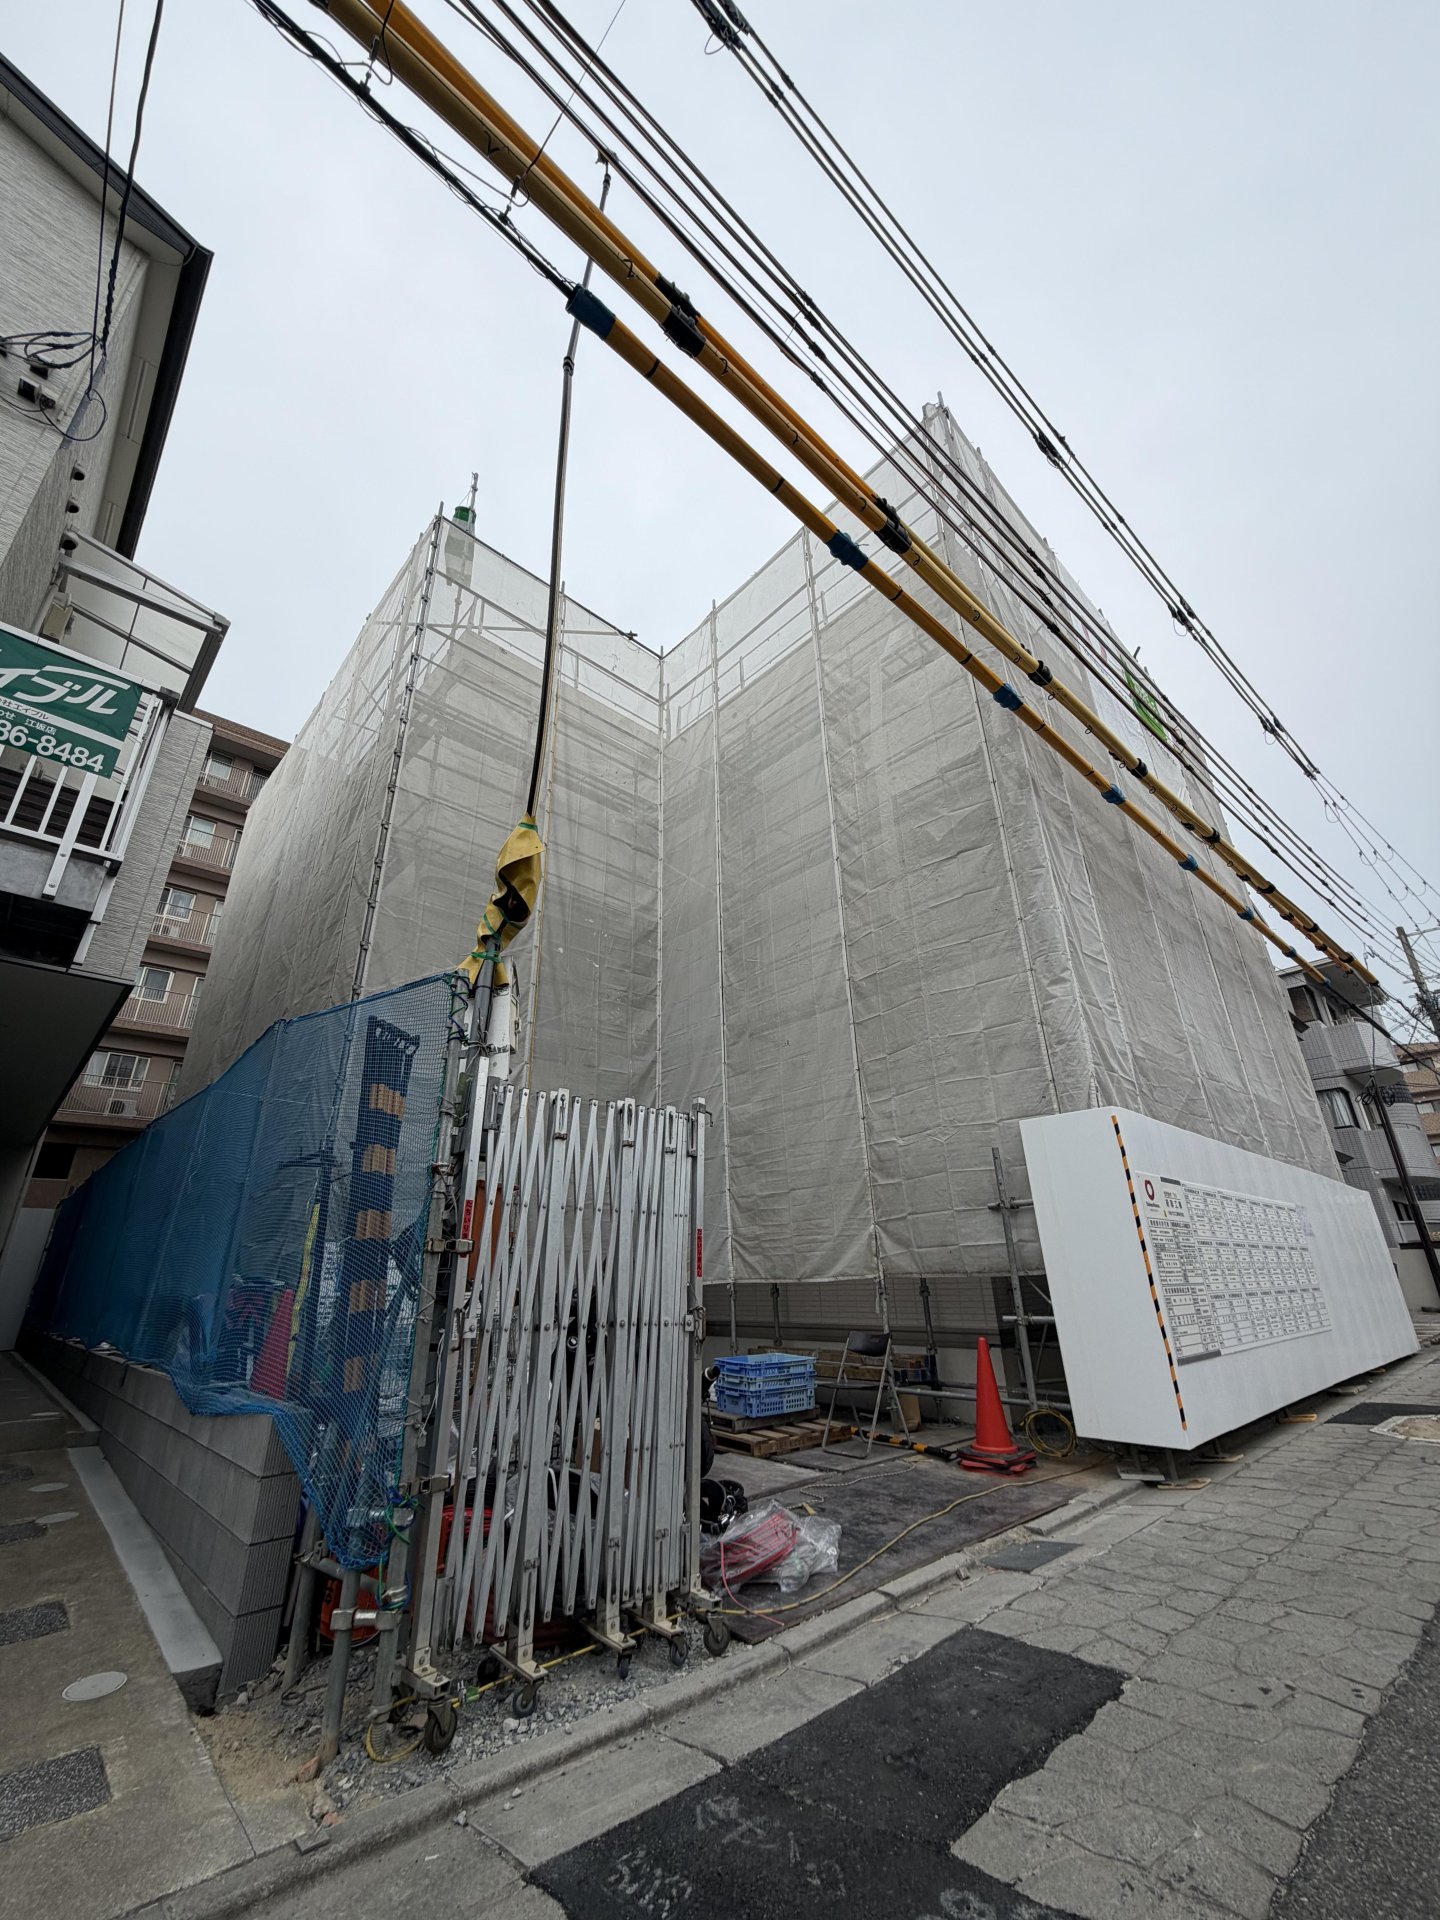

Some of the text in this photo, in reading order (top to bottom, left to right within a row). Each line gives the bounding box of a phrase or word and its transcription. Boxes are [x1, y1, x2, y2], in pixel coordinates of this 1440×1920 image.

[0, 698, 49, 720] 社エイブル
[25, 718, 57, 736] 江坂店
